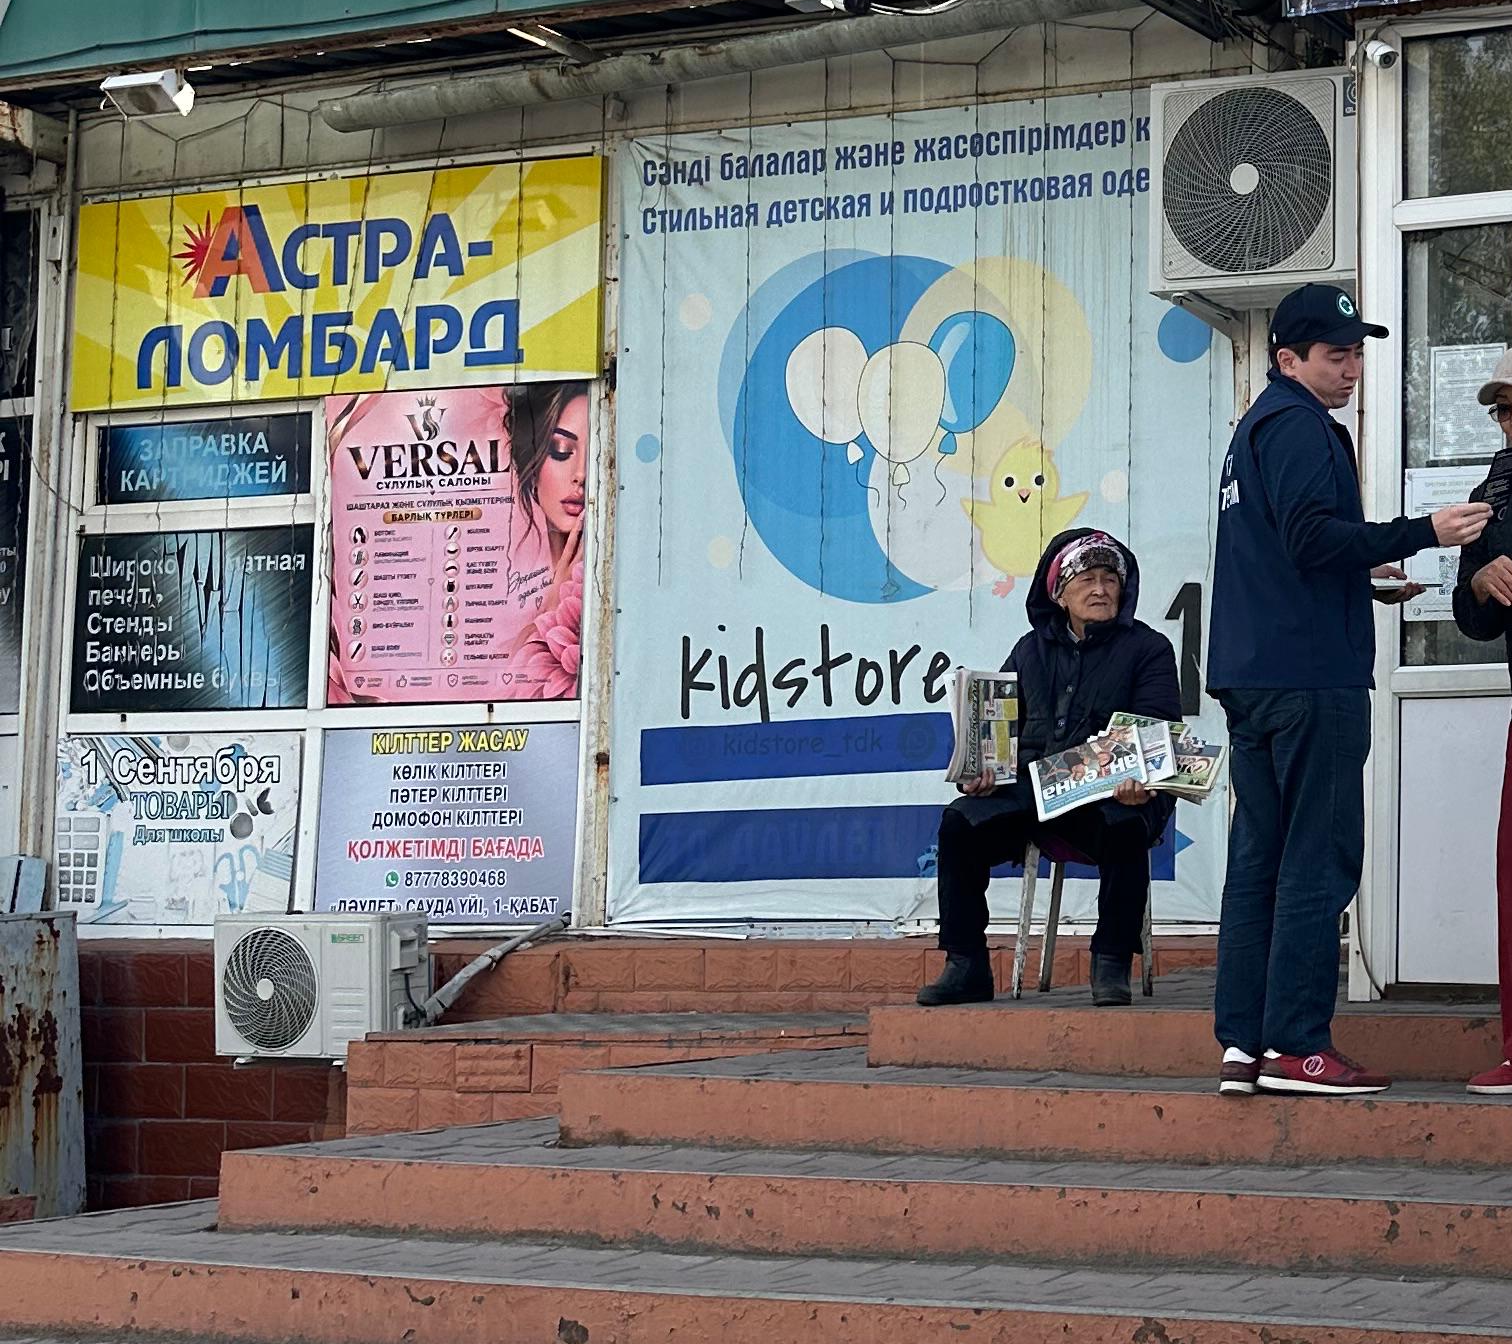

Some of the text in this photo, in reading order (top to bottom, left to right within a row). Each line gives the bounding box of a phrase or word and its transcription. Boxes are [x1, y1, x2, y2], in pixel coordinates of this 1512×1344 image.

[642, 155, 711, 187] Сәнді
[720, 145, 826, 182] балалар
[835, 138, 905, 171] және
[914, 119, 1126, 164] жасөспірімдер
[642, 201, 759, 235] Стильная
[766, 192, 871, 229] детская
[880, 191, 894, 216] и
[903, 171, 1093, 216] подростковая
[136, 298, 524, 390] ЛОМБАРД
[139, 432, 270, 461] ЗАПРАВКА
[346, 439, 510, 480] VERSAL
[438, 477, 491, 487] САЛОНЫ
[87, 612, 172, 636] Стенды
[84, 668, 205, 692] Объемные
[681, 623, 952, 724] kidstore
[371, 729, 529, 754] КІЛТТЕР ЖАСАУ
[81, 746, 280, 792] 1 Сентября
[392, 763, 507, 780] КӨЛІК КІЛТТЕРІ
[130, 791, 230, 820] ТОВАРЫ
[390, 787, 507, 804] ПӘТЕР КІЛТТЕРІ
[372, 810, 523, 830] ДОМОФОН КІЛТТЕРІ
[133, 825, 225, 845] Для школы
[347, 837, 544, 862] ҚОЛЖЕТІМДІ БАҒАДА
[404, 870, 507, 887] 87778390468
[407, 897, 454, 916] САУДА
[495, 897, 558, 916] 1-ҚАБАТ
